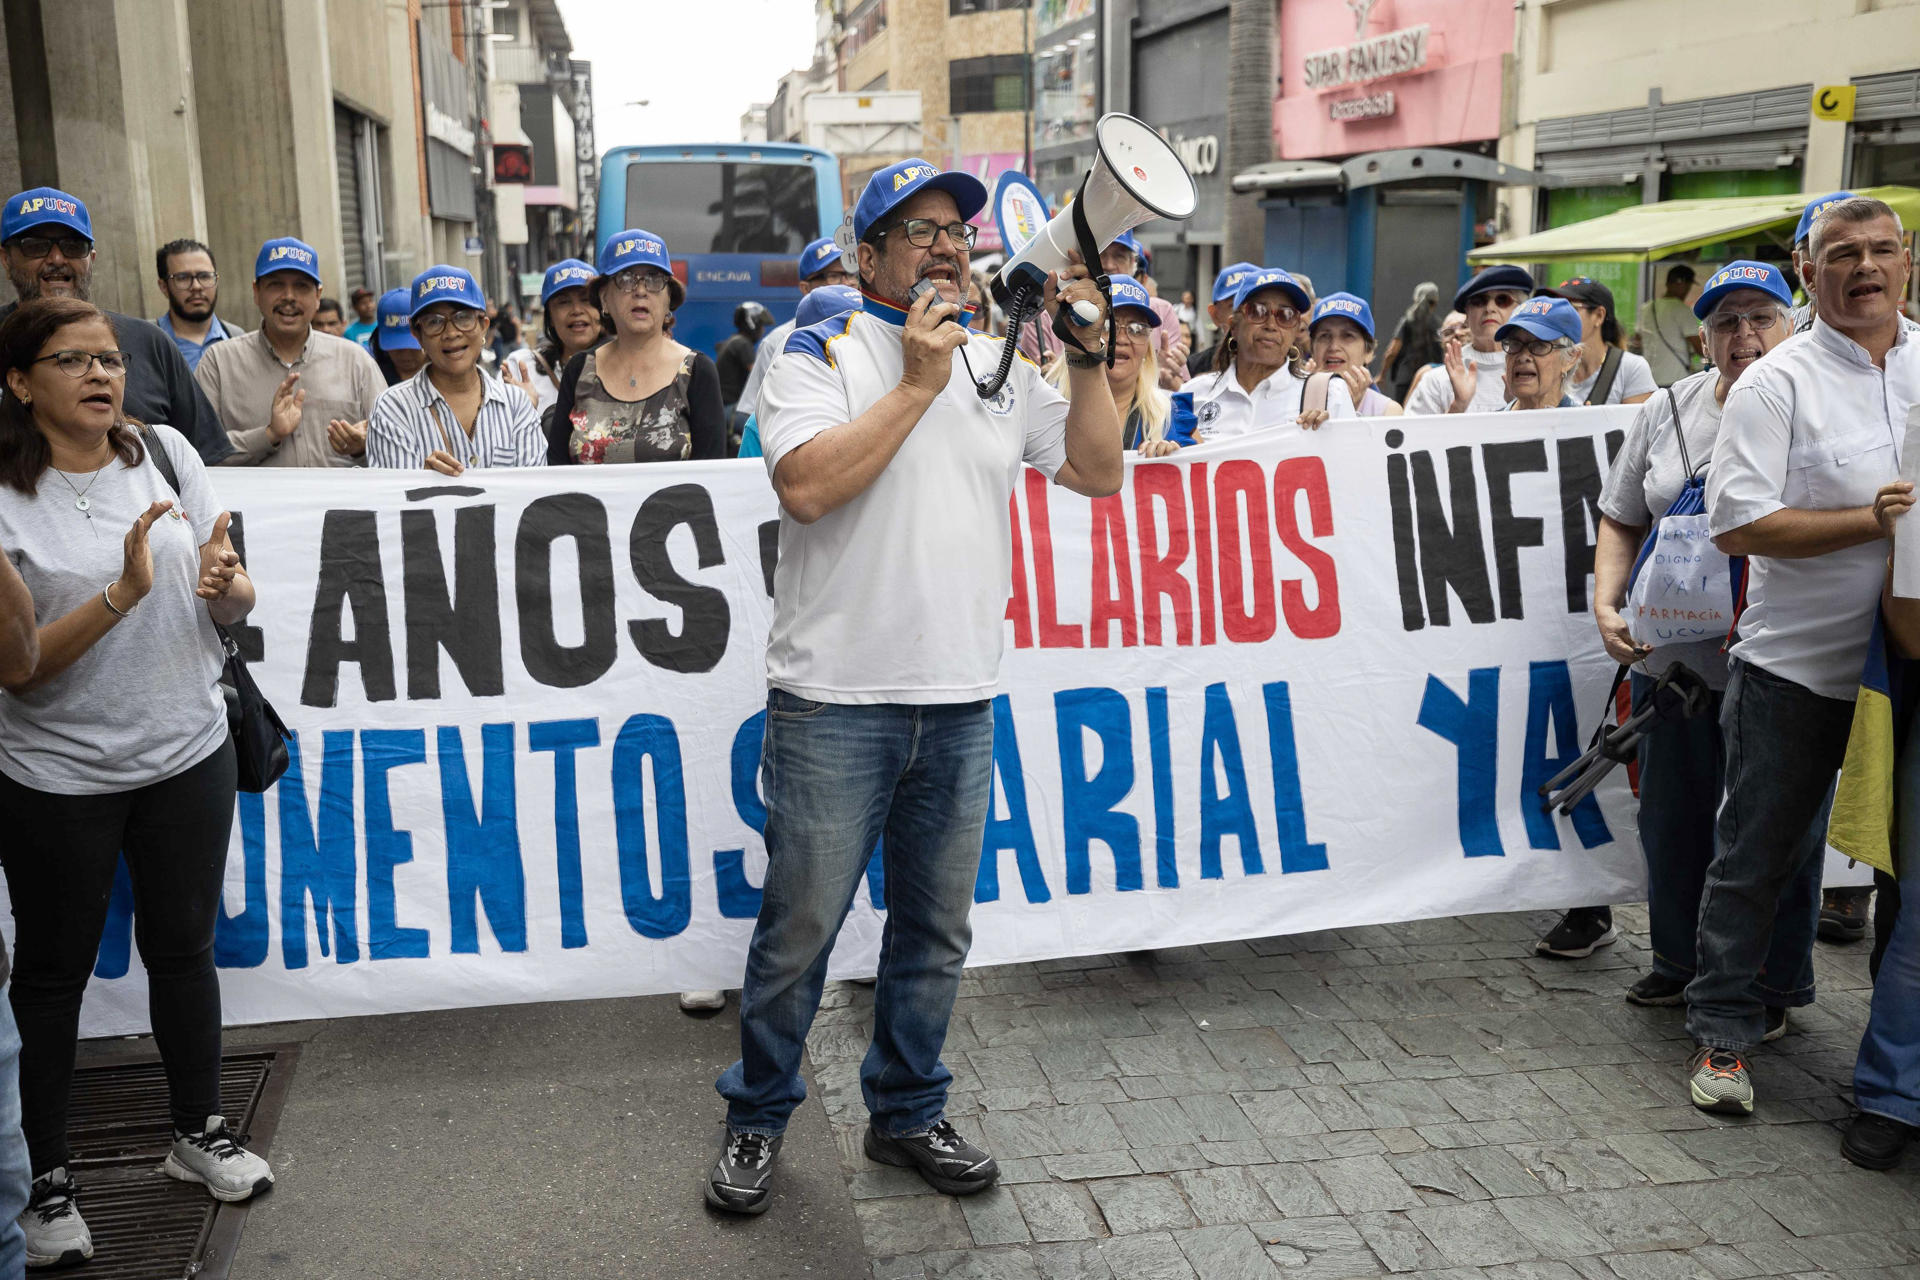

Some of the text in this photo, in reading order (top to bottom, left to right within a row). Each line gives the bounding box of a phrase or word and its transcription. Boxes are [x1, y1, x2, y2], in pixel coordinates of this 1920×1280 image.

[1304, 24, 1429, 88] STAR FANTASY
[20, 197, 77, 217] APUCV
[269, 246, 312, 265] APUCV
[616, 239, 662, 256] APUCV
[696, 271, 752, 282] ENCAVA
[1711, 266, 1769, 288] APUCV
[419, 276, 466, 298] APUCV
[1319, 300, 1362, 316] APUCV
[1655, 554, 1702, 566] DIGNO
[300, 483, 731, 709] AÑOS
[1004, 456, 1342, 649] ALARIOS
[1656, 628, 1705, 640] UCV
[93, 713, 692, 979] UMENTO
[1416, 659, 1614, 858] YA
